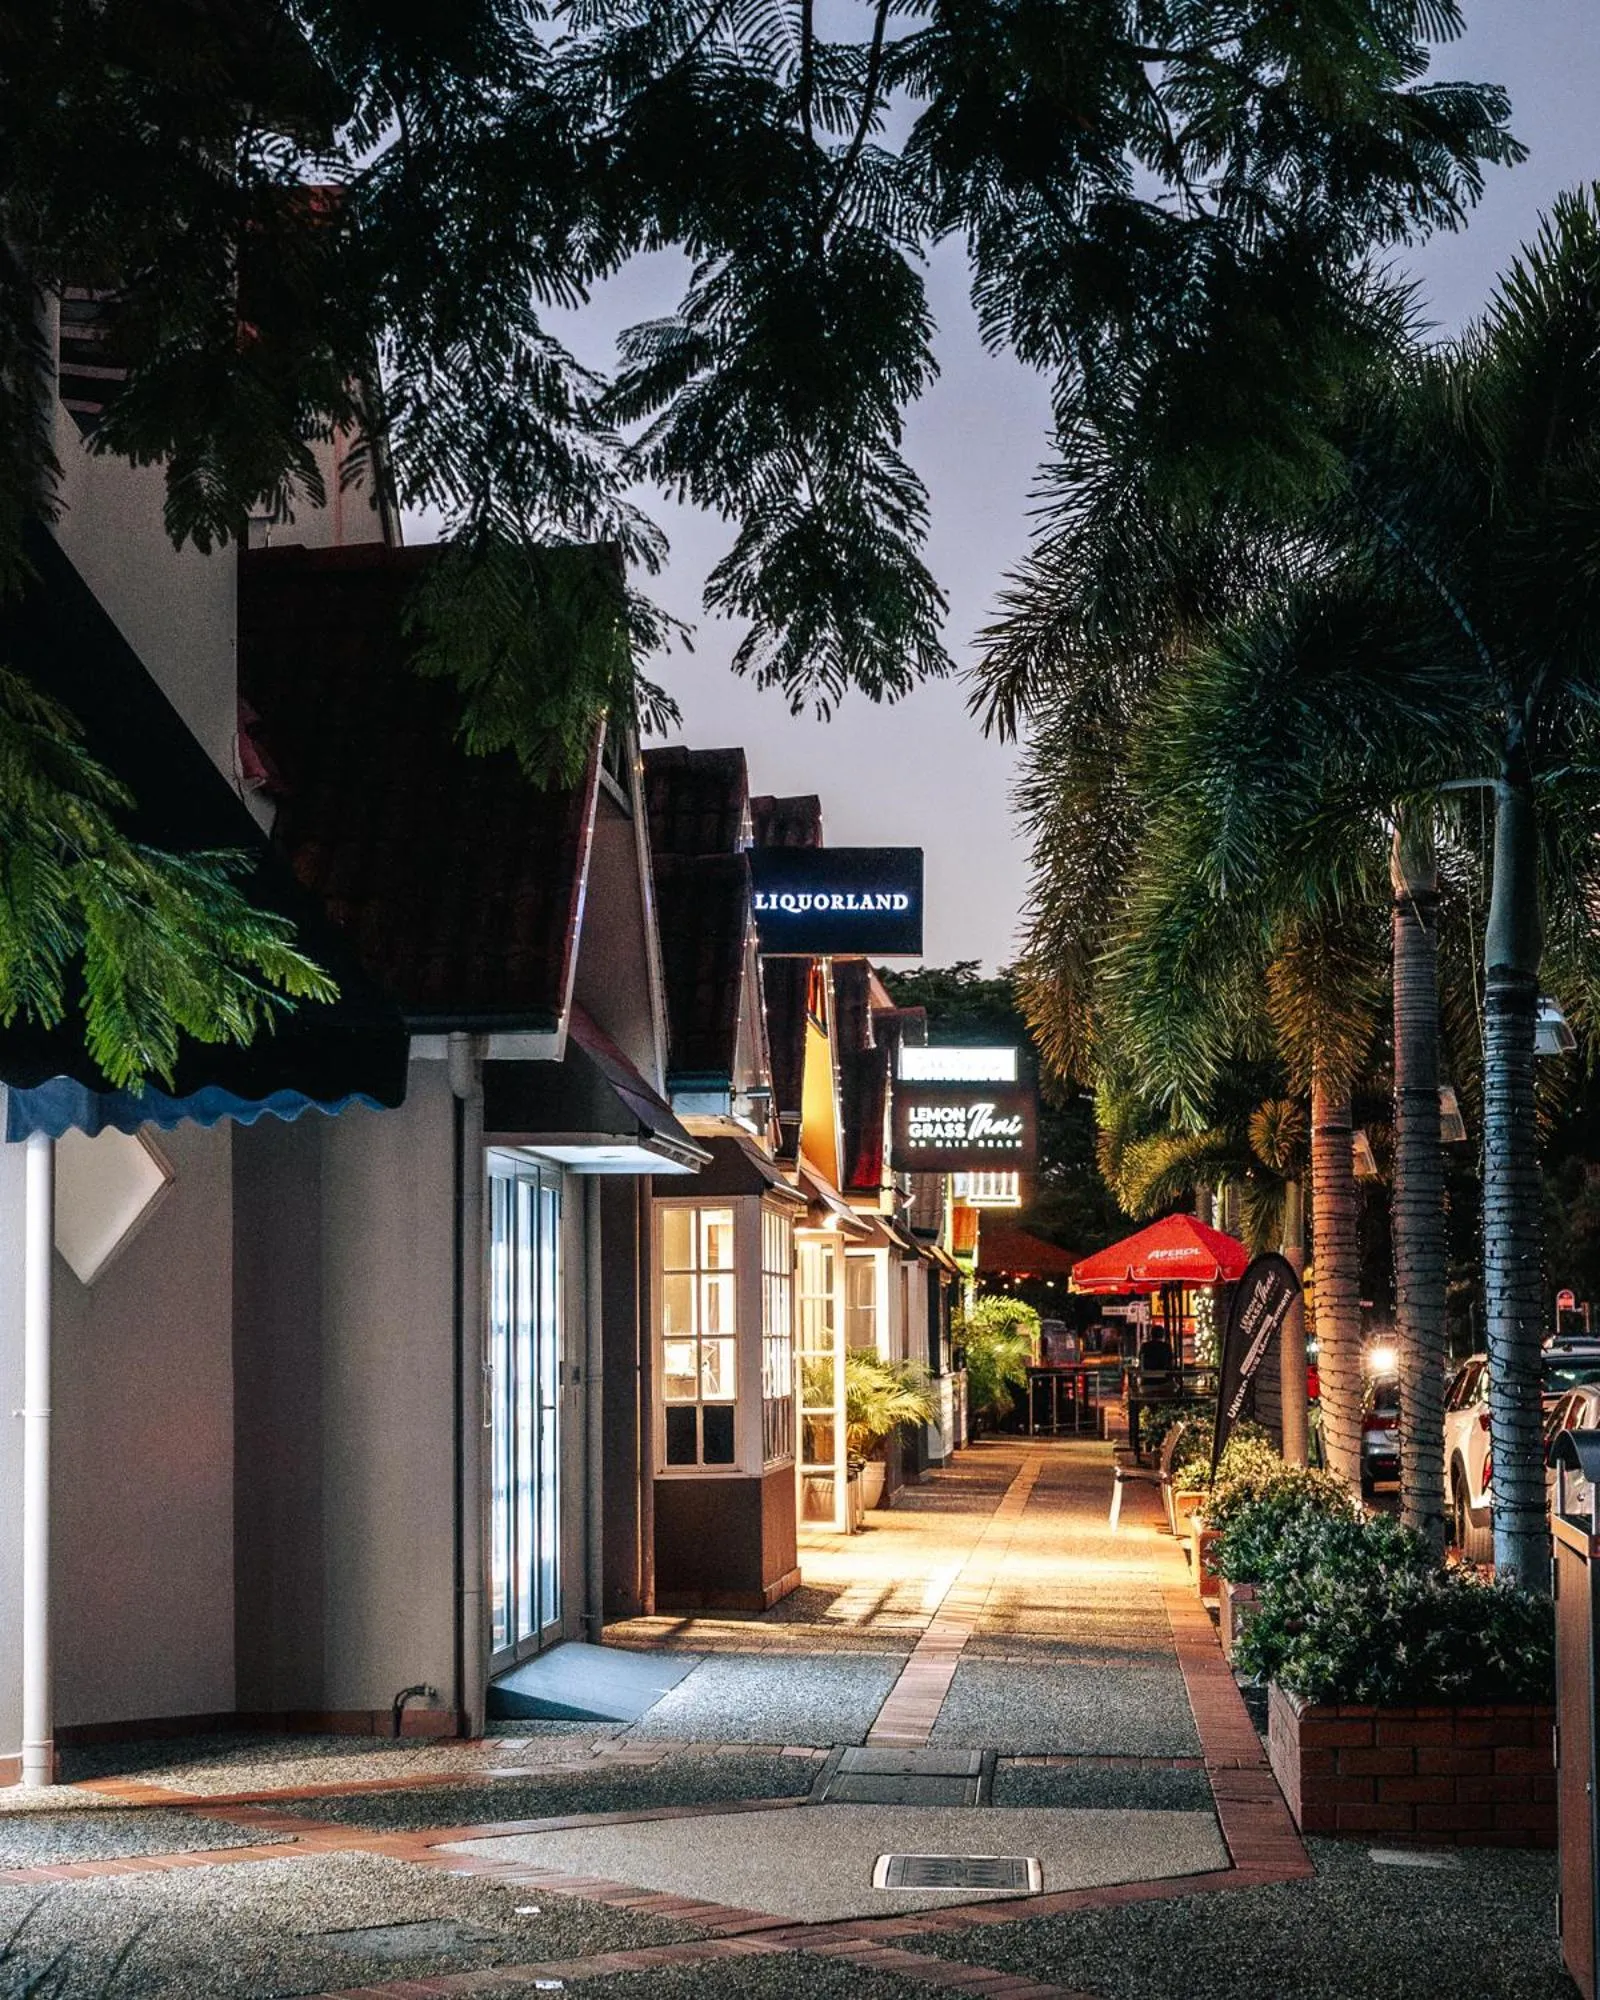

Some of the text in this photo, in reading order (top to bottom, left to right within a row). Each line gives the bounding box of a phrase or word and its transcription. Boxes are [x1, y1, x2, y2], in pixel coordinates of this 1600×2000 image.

[755, 894, 909, 913] LIQUORLAND
[908, 1107, 966, 1122] LEMON
[967, 1102, 1024, 1140] Thai
[908, 1123, 966, 1138] GRASS
[1148, 1248, 1202, 1260] APEROL
